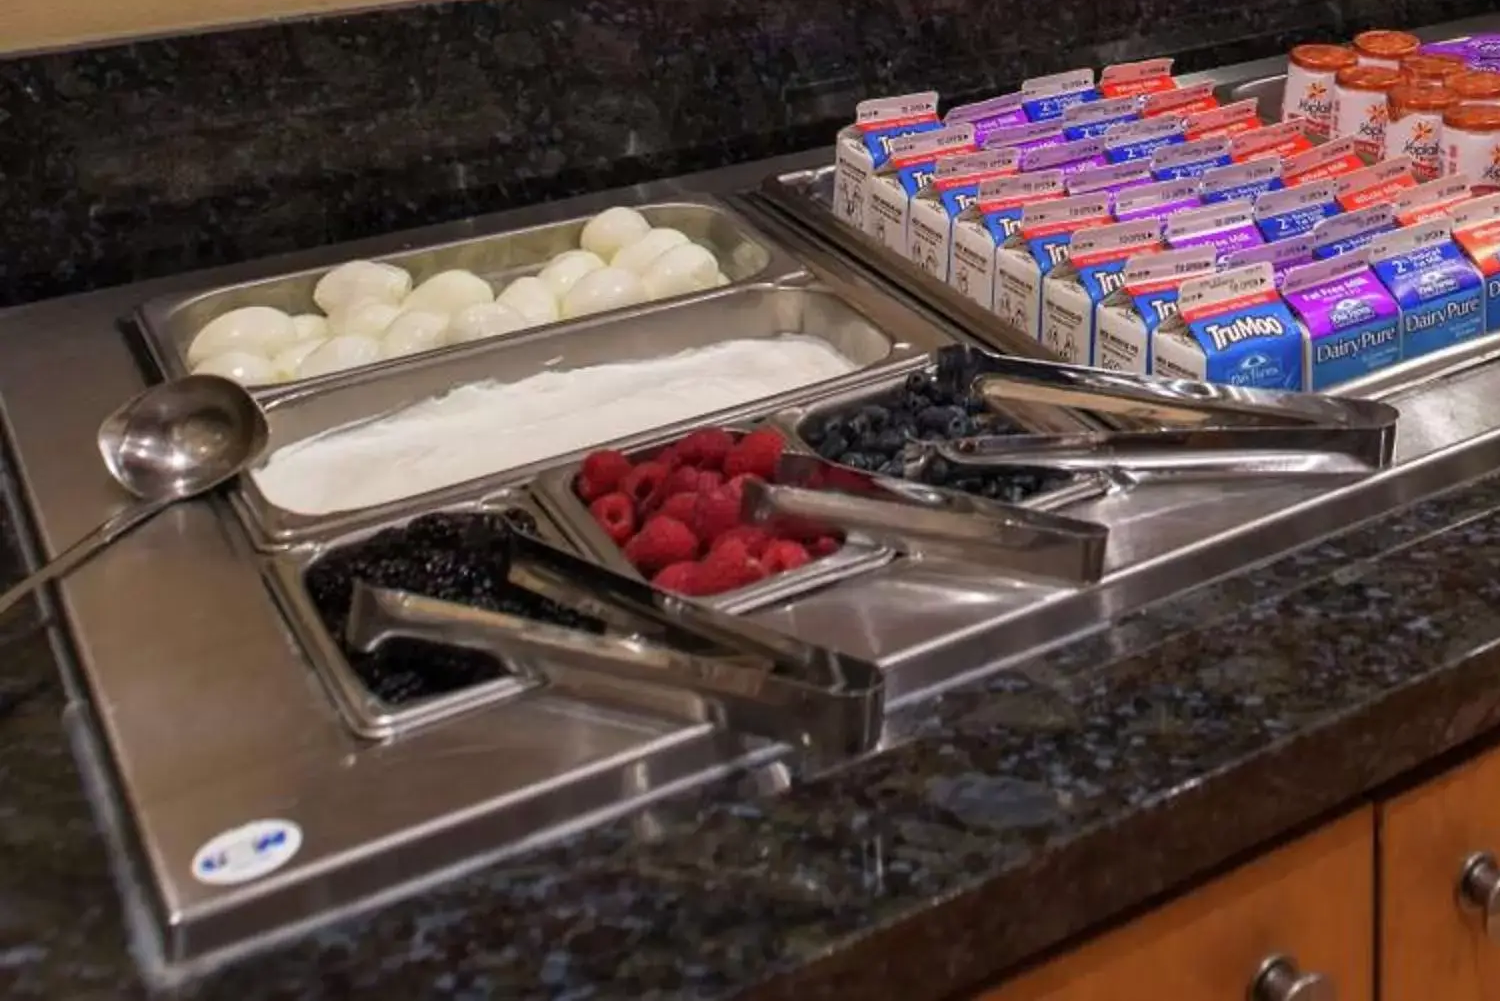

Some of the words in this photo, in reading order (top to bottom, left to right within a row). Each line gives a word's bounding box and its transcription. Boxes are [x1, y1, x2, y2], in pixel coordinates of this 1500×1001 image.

[1205, 315, 1284, 350] TruMoo
[1405, 299, 1479, 333] DairyPure
[1317, 326, 1394, 362] DairyPure
